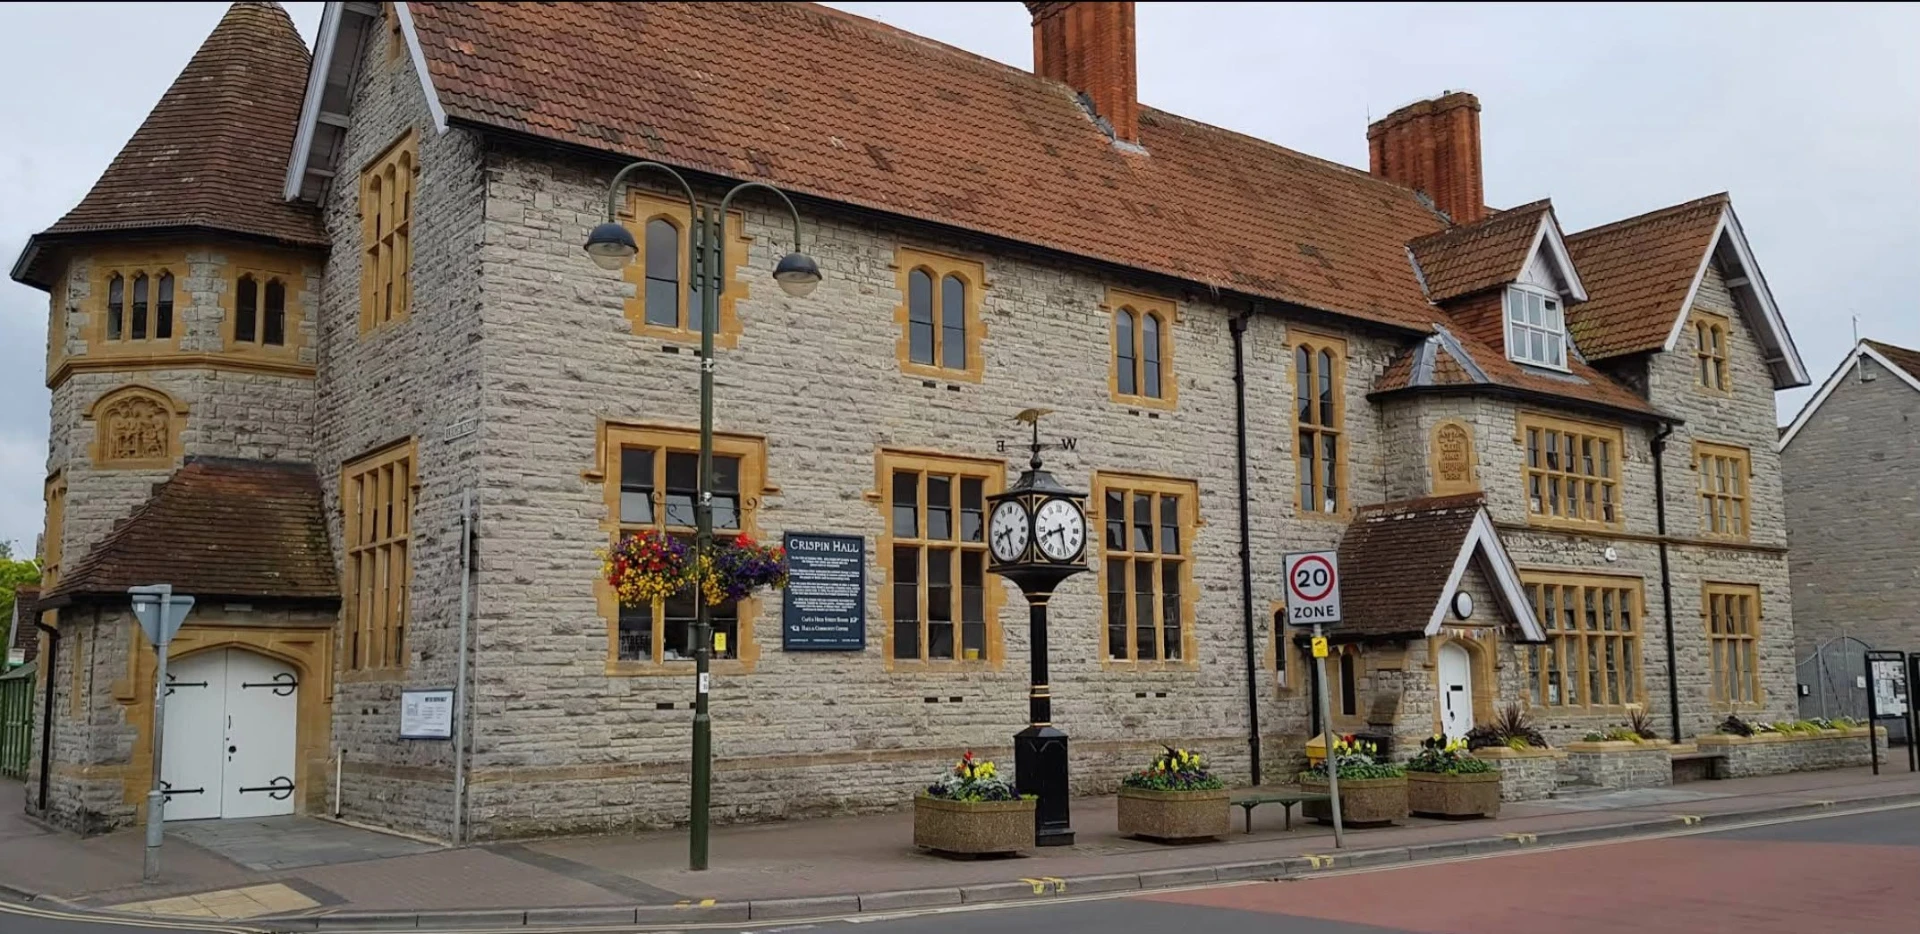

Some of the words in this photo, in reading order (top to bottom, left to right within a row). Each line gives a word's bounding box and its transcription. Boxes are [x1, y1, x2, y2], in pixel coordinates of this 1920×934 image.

[1061, 438, 1078, 450] W
[790, 538, 830, 552] CRISPIN
[832, 540, 859, 553] HALL
[1297, 568, 1328, 588] 20
[1294, 605, 1335, 619] ZONE
